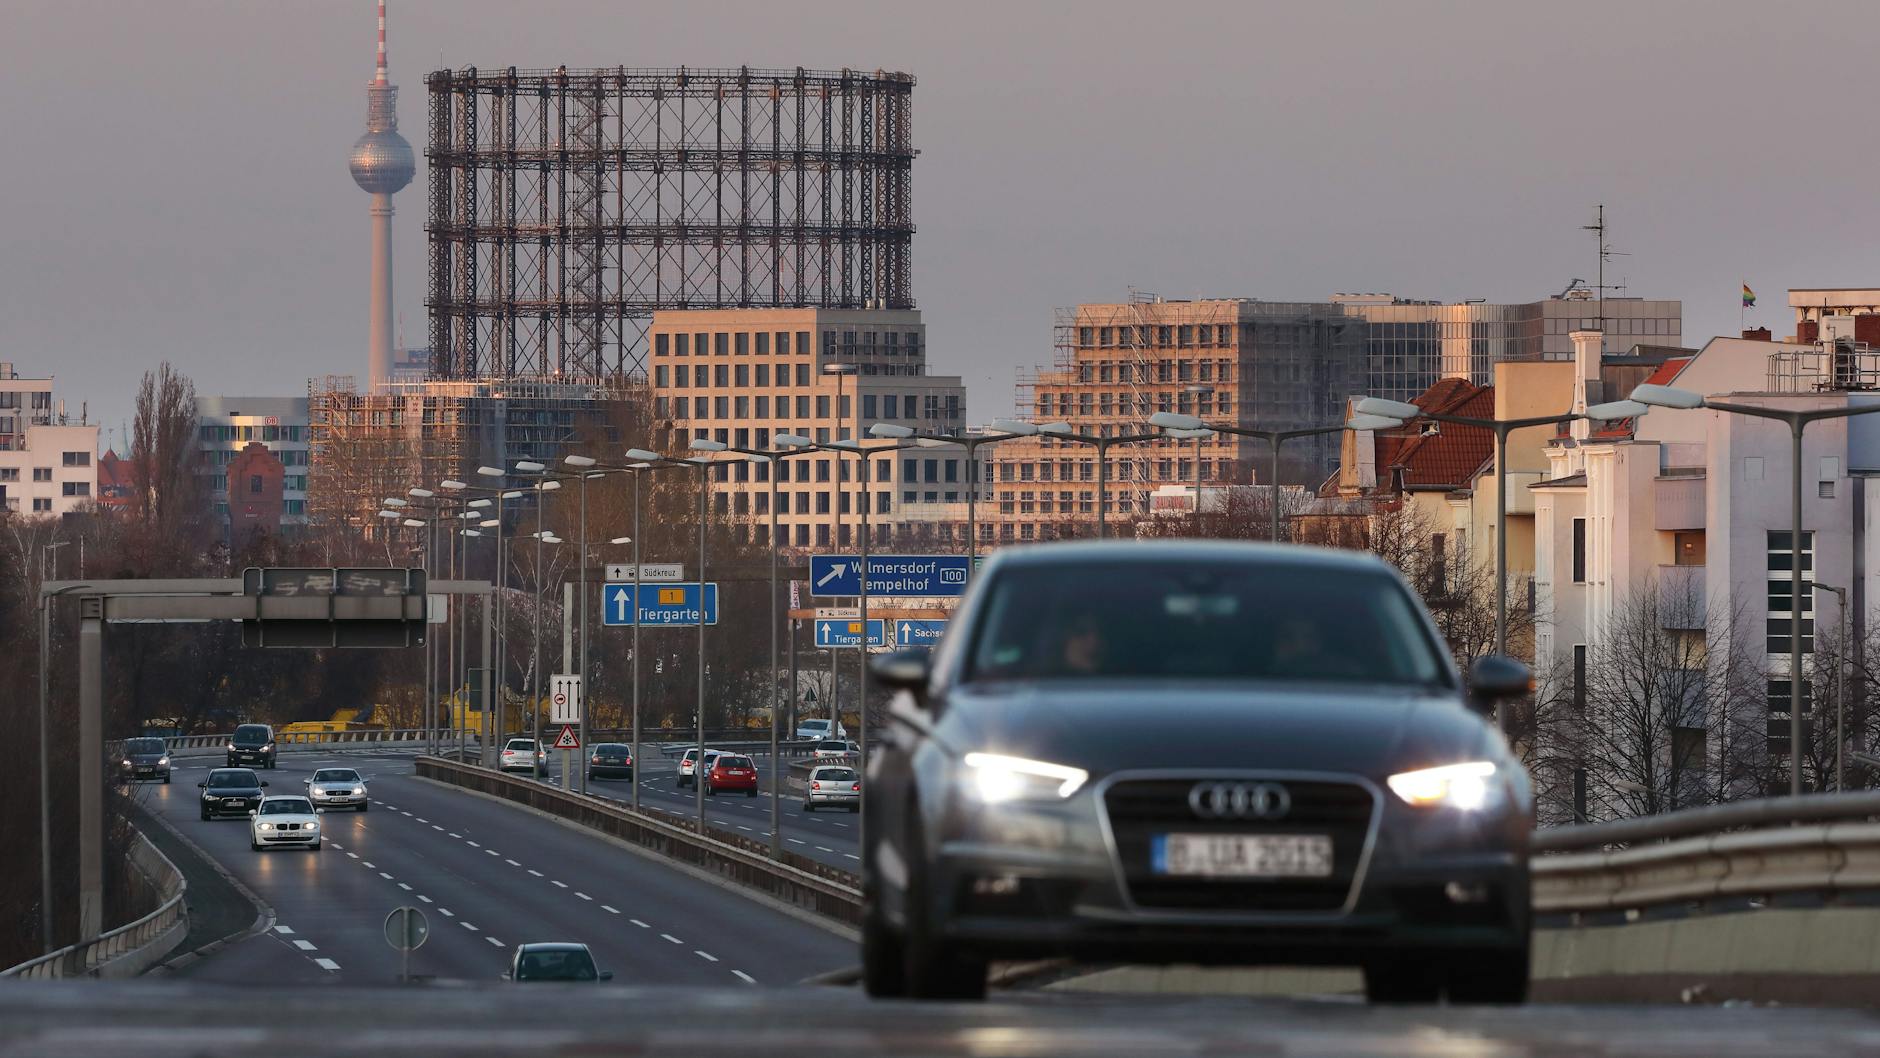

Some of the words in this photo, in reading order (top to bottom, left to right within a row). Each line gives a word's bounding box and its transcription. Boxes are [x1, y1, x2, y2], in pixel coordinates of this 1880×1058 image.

[644, 568, 676, 577] Südkreuz
[851, 562, 936, 574] Wlmersdorf
[944, 571, 962, 581] 100
[670, 592, 674, 601] 1
